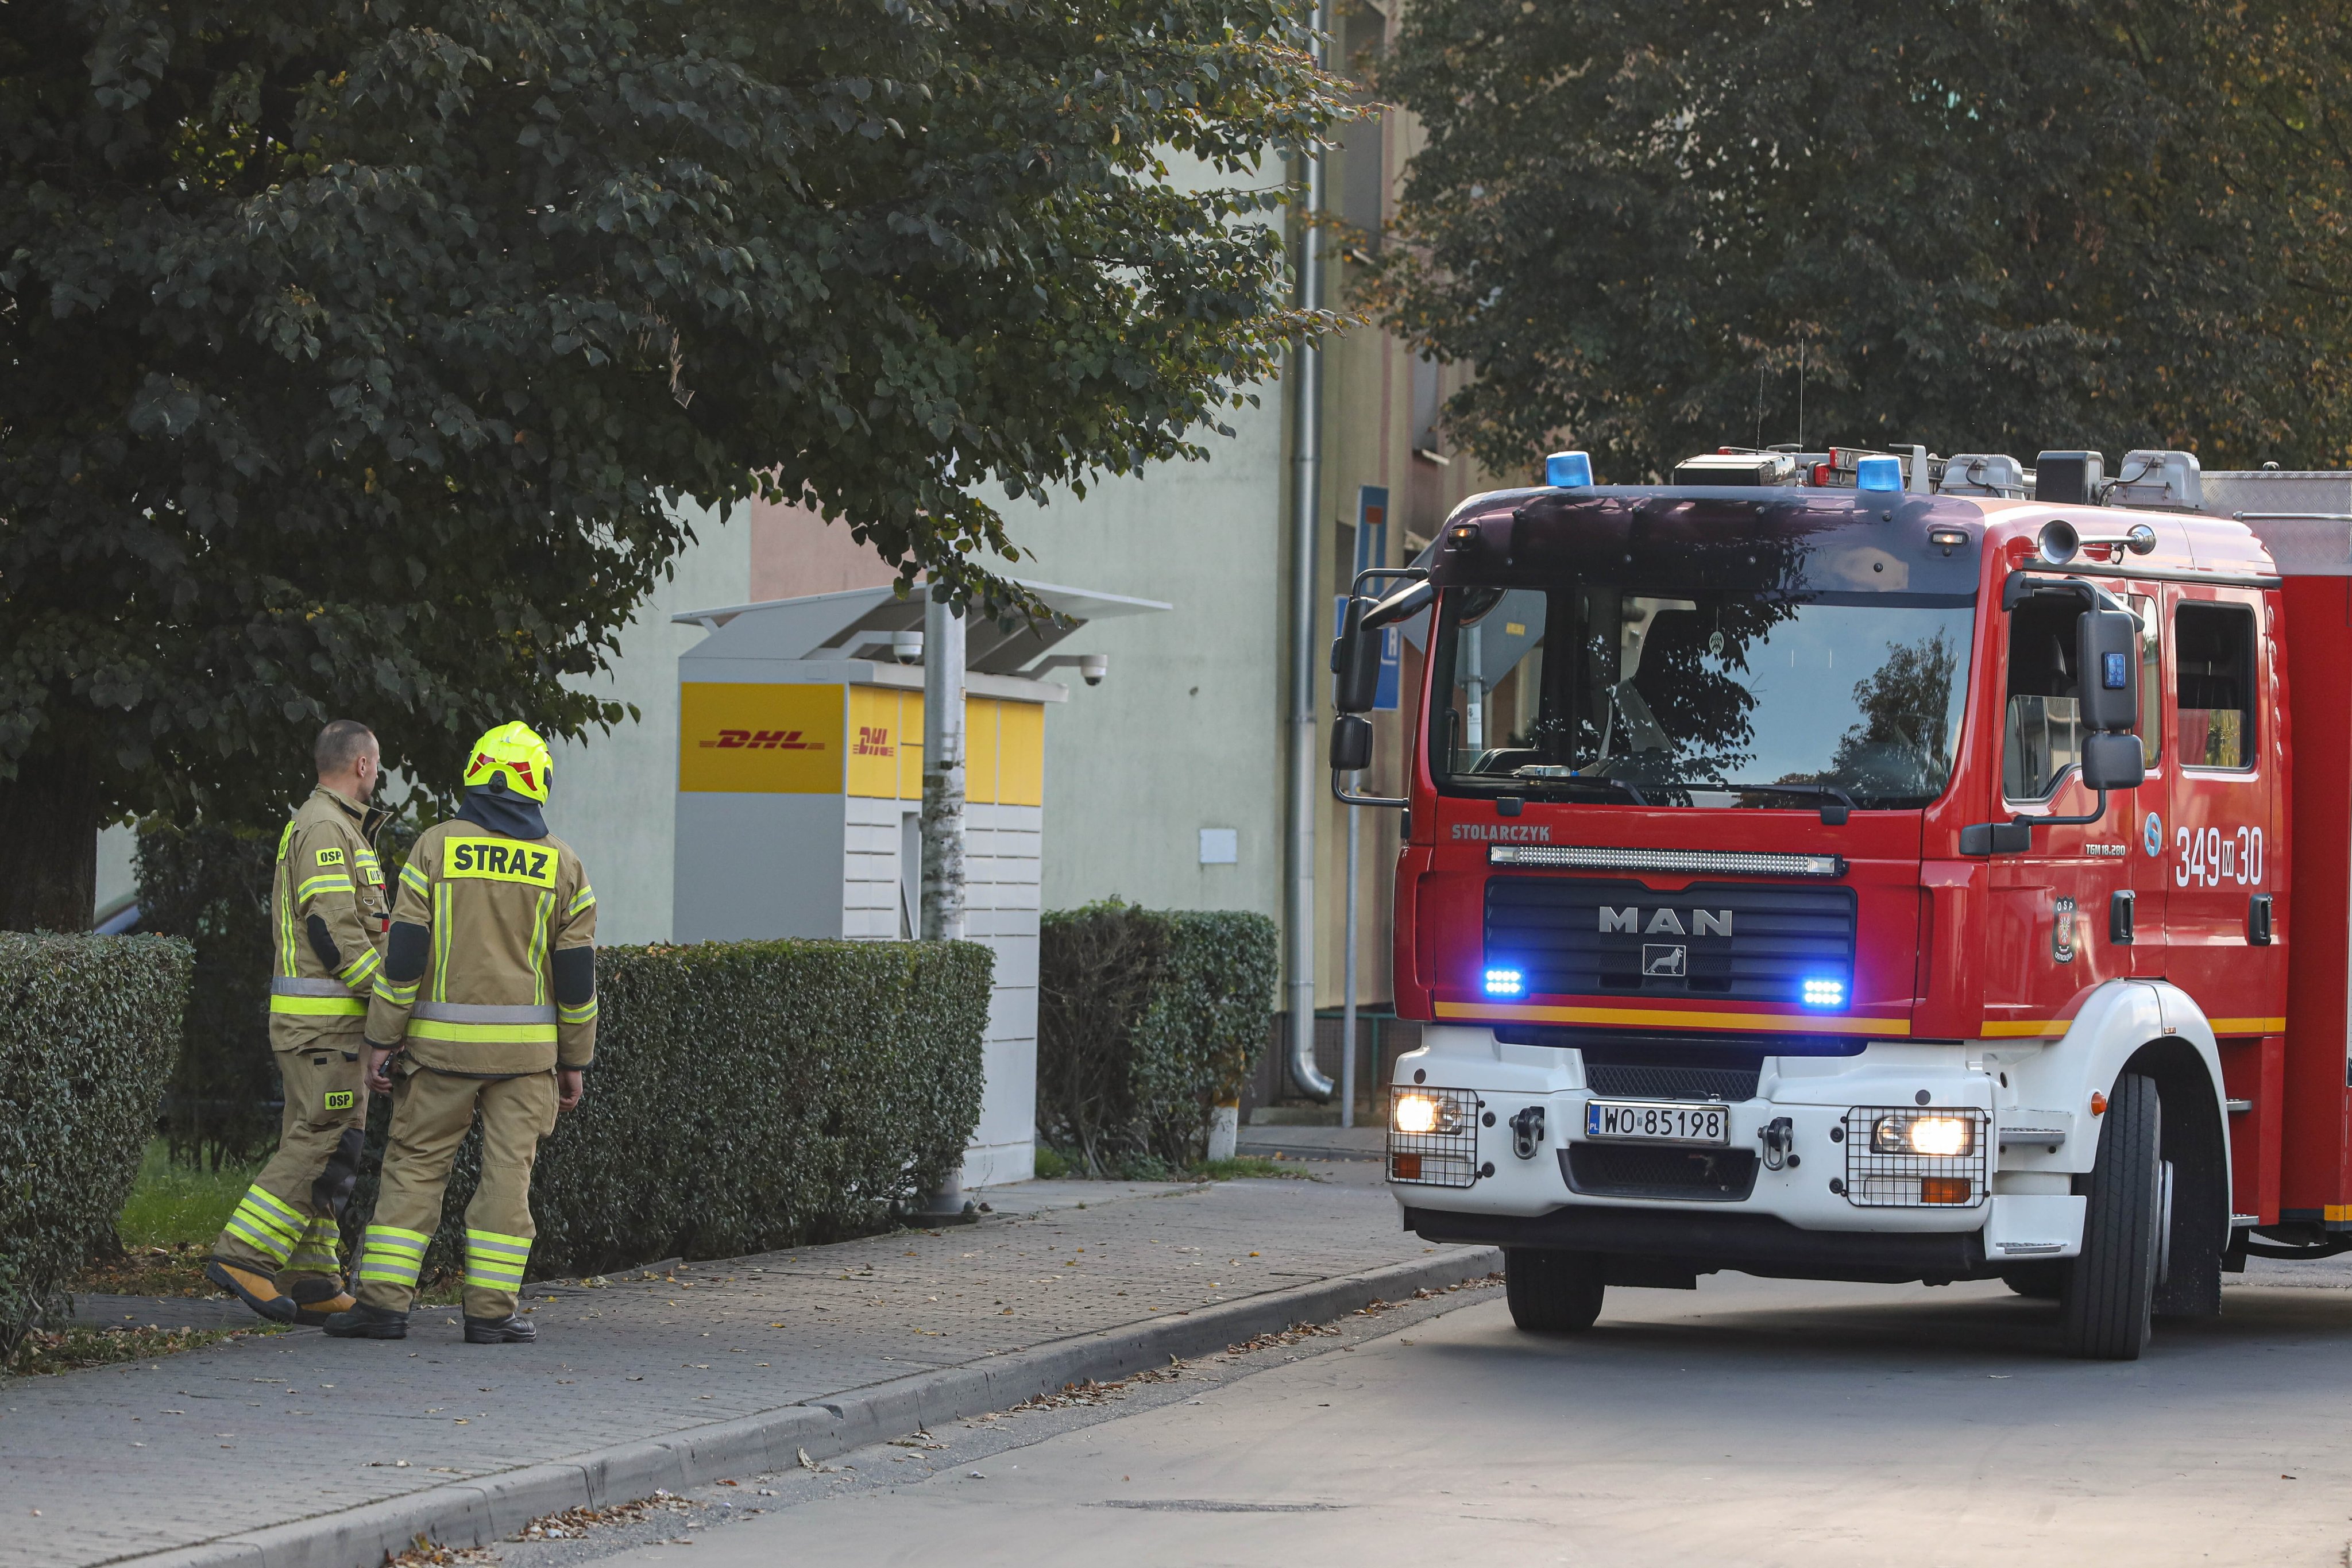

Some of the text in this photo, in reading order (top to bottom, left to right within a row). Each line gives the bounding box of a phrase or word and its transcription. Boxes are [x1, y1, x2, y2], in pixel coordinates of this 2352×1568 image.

[699, 729, 825, 750] DHL
[853, 727, 894, 756] DHL
[1452, 824, 1550, 841] STOLARCZYK
[320, 851, 341, 862] OSP
[2085, 844, 2125, 856] TGM 18.280
[370, 870, 381, 881] OSP
[2057, 900, 2073, 912] OSP
[1599, 906, 1732, 937] MAN
[329, 1094, 350, 1107] OSP
[1605, 1107, 1719, 1137] WO 85198
